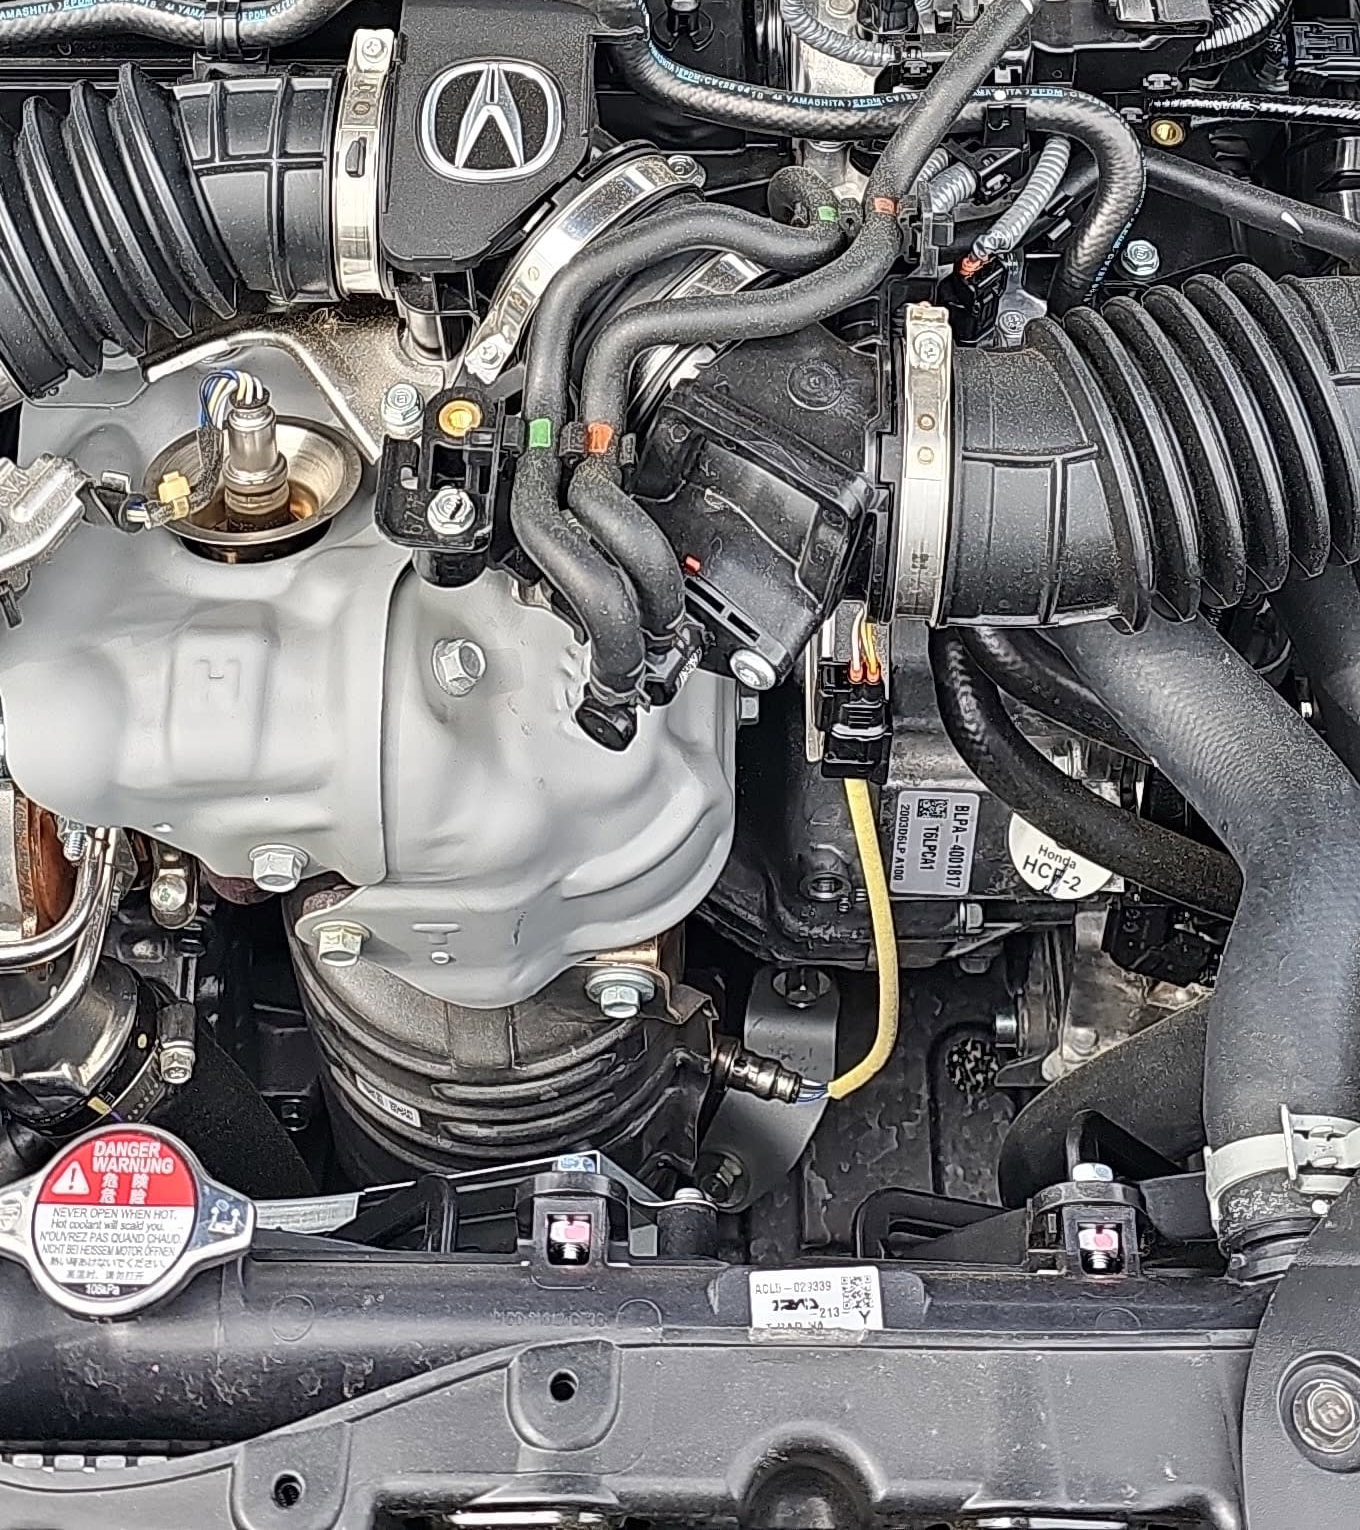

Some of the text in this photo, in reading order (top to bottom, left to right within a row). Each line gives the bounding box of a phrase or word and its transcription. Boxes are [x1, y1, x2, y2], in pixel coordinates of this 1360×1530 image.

[786, 94, 846, 108] YAMASHITA
[893, 804, 910, 881] 2003D6LP A100
[919, 825, 939, 870] T6LPCA1
[945, 805, 970, 888] BLPA-4001817
[1038, 844, 1077, 870] Honda
[93, 1140, 161, 1157] DANGER
[92, 1156, 174, 1173] WARNUNG
[52, 1208, 87, 1217] NEVER
[89, 1208, 119, 1218] OPEN
[121, 1209, 151, 1219] WHEN
[51, 1220, 67, 1229] Hot
[69, 1220, 102, 1230] coolant
[104, 1220, 118, 1230] will
[119, 1220, 145, 1230] scald
[89, 1232, 109, 1243] PAS
[111, 1232, 145, 1244] QUAND
[41, 1244, 65, 1254] NICHT
[66, 1244, 80, 1254] BEI
[80, 1245, 113, 1255] HEISSEM
[114, 1246, 143, 1256] MOTOR
